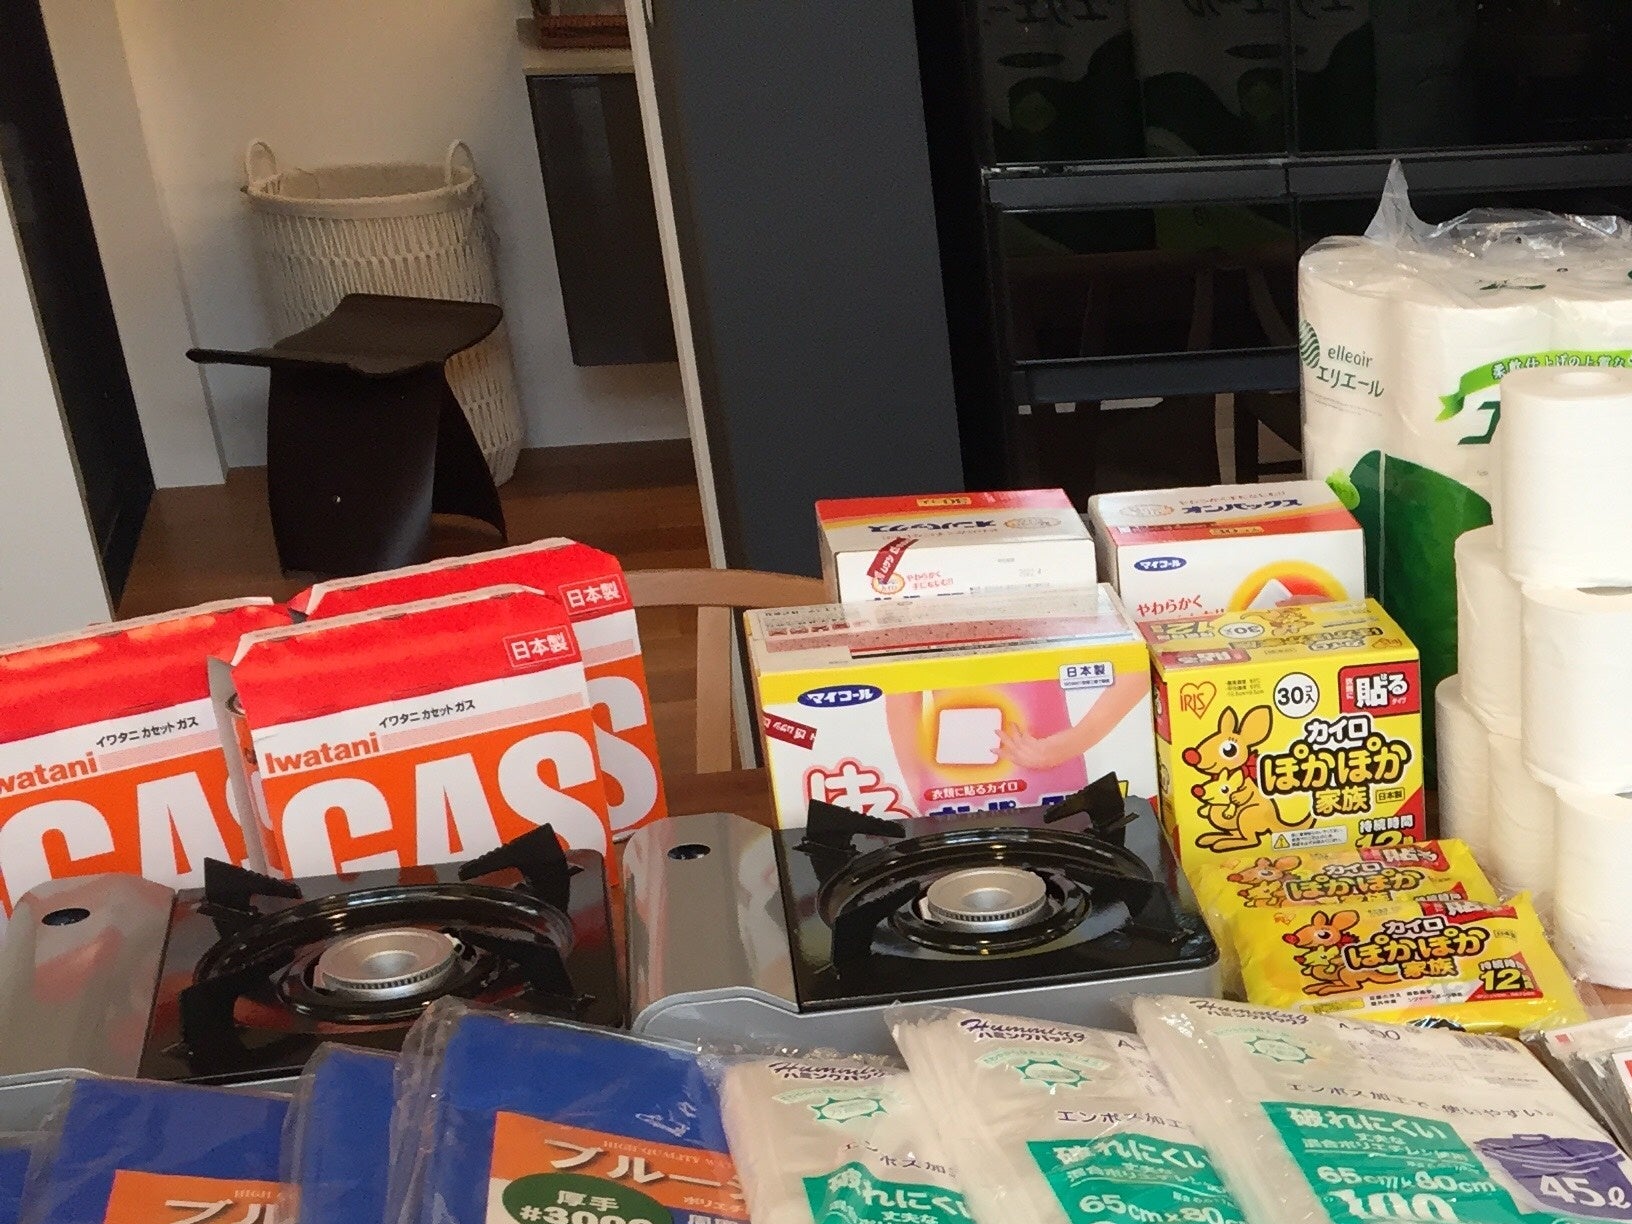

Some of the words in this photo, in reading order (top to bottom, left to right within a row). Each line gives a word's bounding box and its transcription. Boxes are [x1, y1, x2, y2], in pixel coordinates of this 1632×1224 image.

[1327, 344, 1373, 370] elleair
[1316, 364, 1385, 399] エリエール
[1182, 499, 1302, 514] オンパックス
[1140, 559, 1180, 570] マイコール
[566, 582, 622, 609] 日本製
[1136, 595, 1203, 617] やわらかく
[511, 633, 571, 660] 日本製
[1067, 665, 1105, 678] 日本製
[806, 690, 874, 704] マイコール
[1180, 693, 1205, 712] IRIS
[1356, 673, 1408, 707] 貼る
[1307, 718, 1369, 744] カイロ
[265, 732, 379, 774] Iwatani
[1263, 736, 1408, 791] ぽかぽか
[931, 782, 1019, 800] 衣類に貼るカイロ
[1316, 788, 1370, 814] 家族
[1378, 789, 1402, 801] 日本製
[1324, 863, 1383, 876] カイロ
[1289, 869, 1424, 899] ぽかぽか
[1384, 918, 1445, 935] カイロ
[1350, 928, 1489, 969] ぽかぽか
[1402, 960, 1456, 978] 家族
[959, 1018, 1086, 1042] Humming
[1290, 1107, 1448, 1139] 破れにくい
[1054, 1135, 1208, 1170] 破れにくい
[556, 1191, 620, 1212] 厚手
